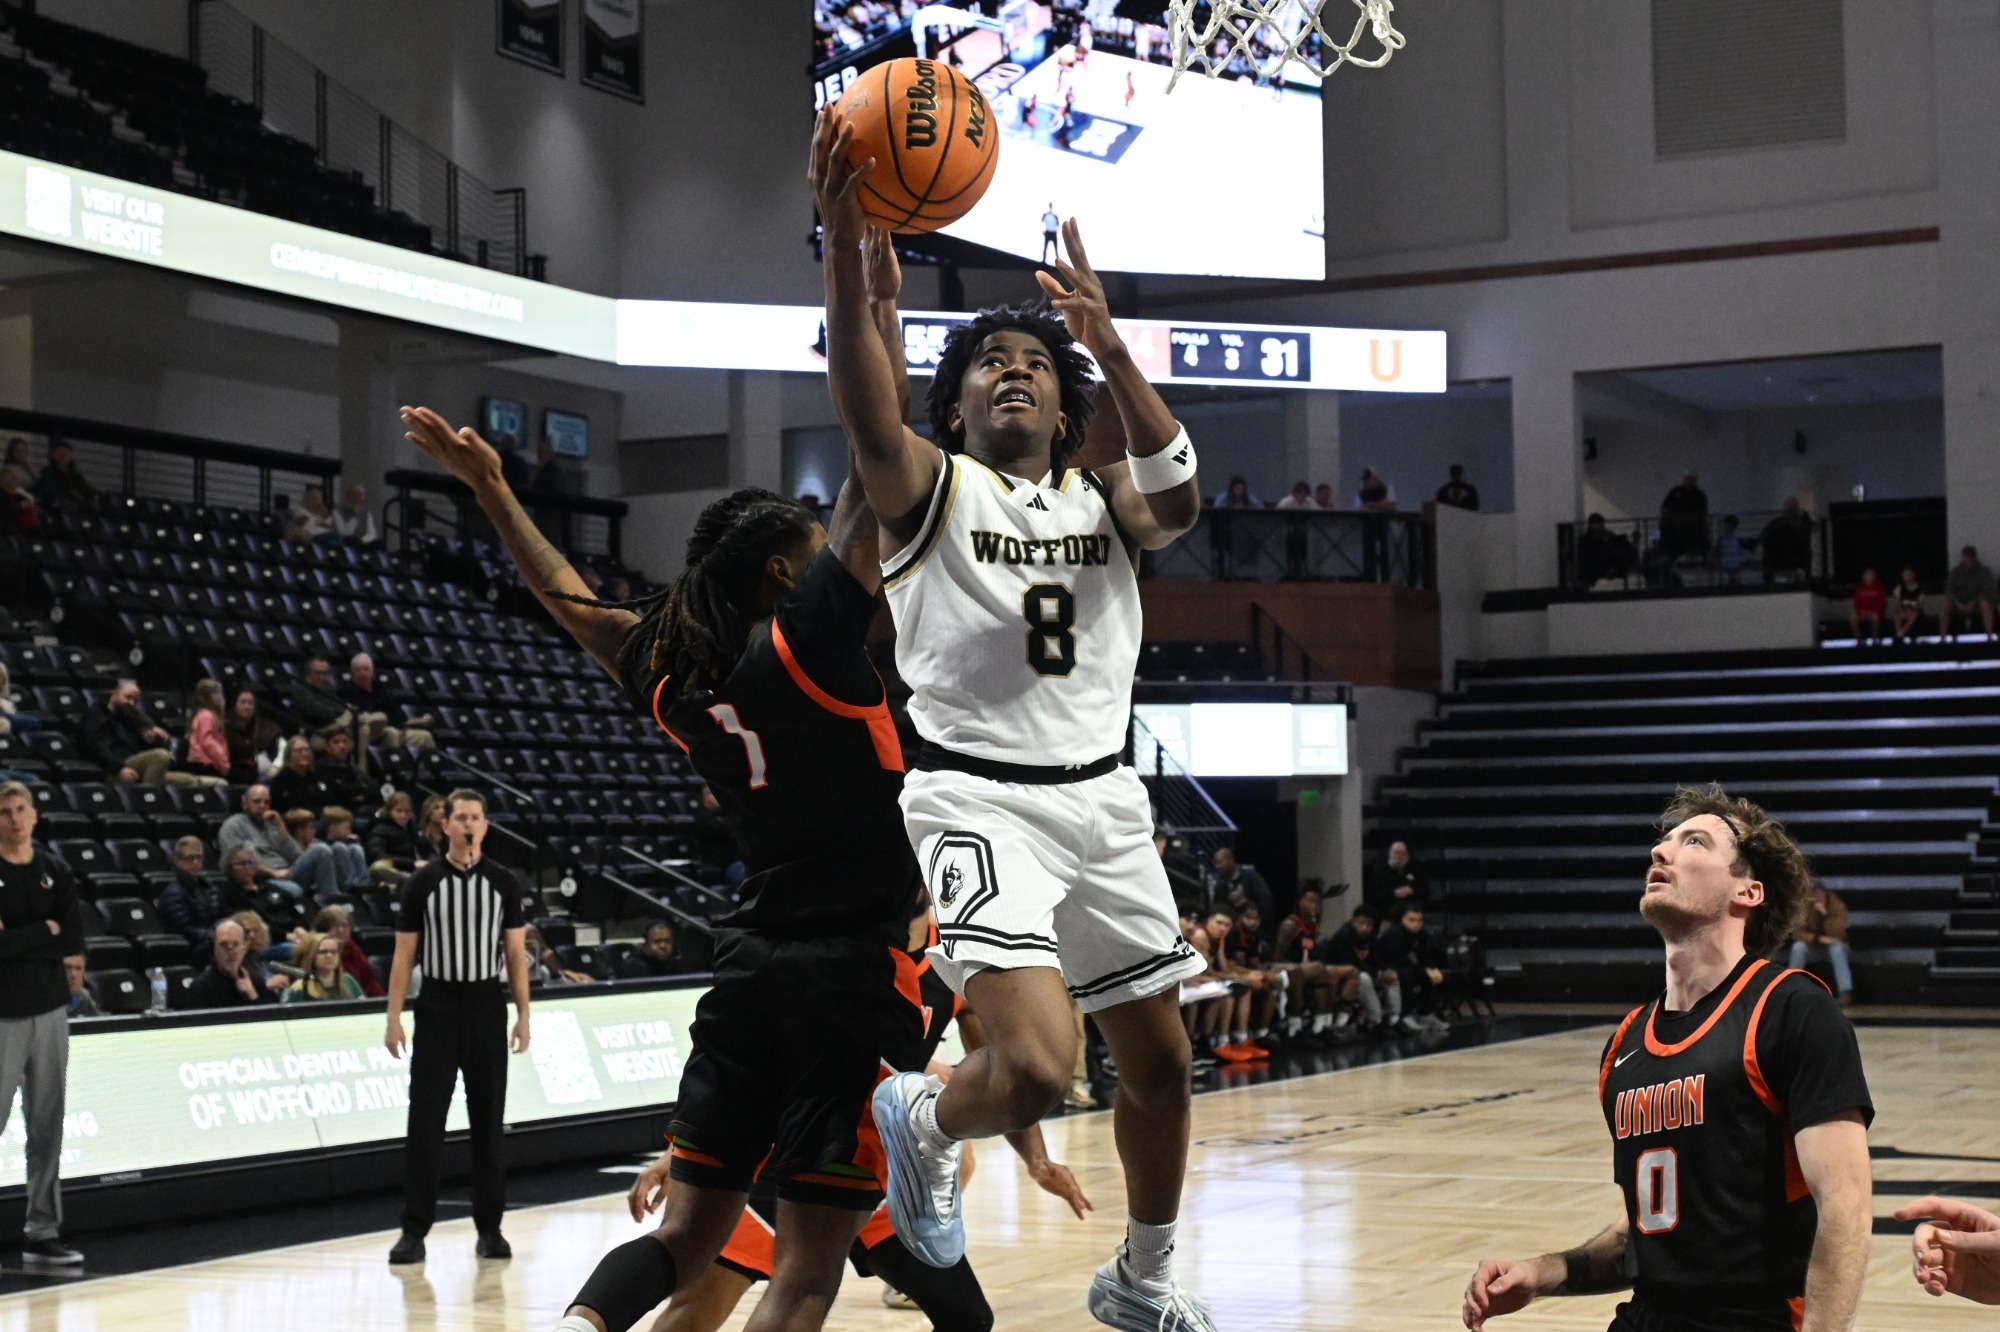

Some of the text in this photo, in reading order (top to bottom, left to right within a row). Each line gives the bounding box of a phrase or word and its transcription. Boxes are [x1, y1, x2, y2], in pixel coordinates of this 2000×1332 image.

[905, 59, 938, 150] Wilson
[81, 185, 163, 226] VISIT OUR
[81, 211, 163, 257] WEBSITE
[1261, 338, 1298, 377] 31
[1369, 338, 1402, 382] U
[970, 529, 1111, 566] WOFFORD
[1020, 582, 1078, 679] 8
[704, 703, 768, 789] 1
[592, 1020, 674, 1049] VISIT OUR
[179, 1056, 283, 1090] OFFICIAL
[282, 1051, 367, 1080] DENTAL
[602, 1047, 683, 1084] WEBSITE
[189, 1091, 226, 1130] OF
[227, 1082, 351, 1125] WOFFORD
[1614, 1074, 1705, 1140] UNION
[1636, 1146, 1679, 1235] 0
